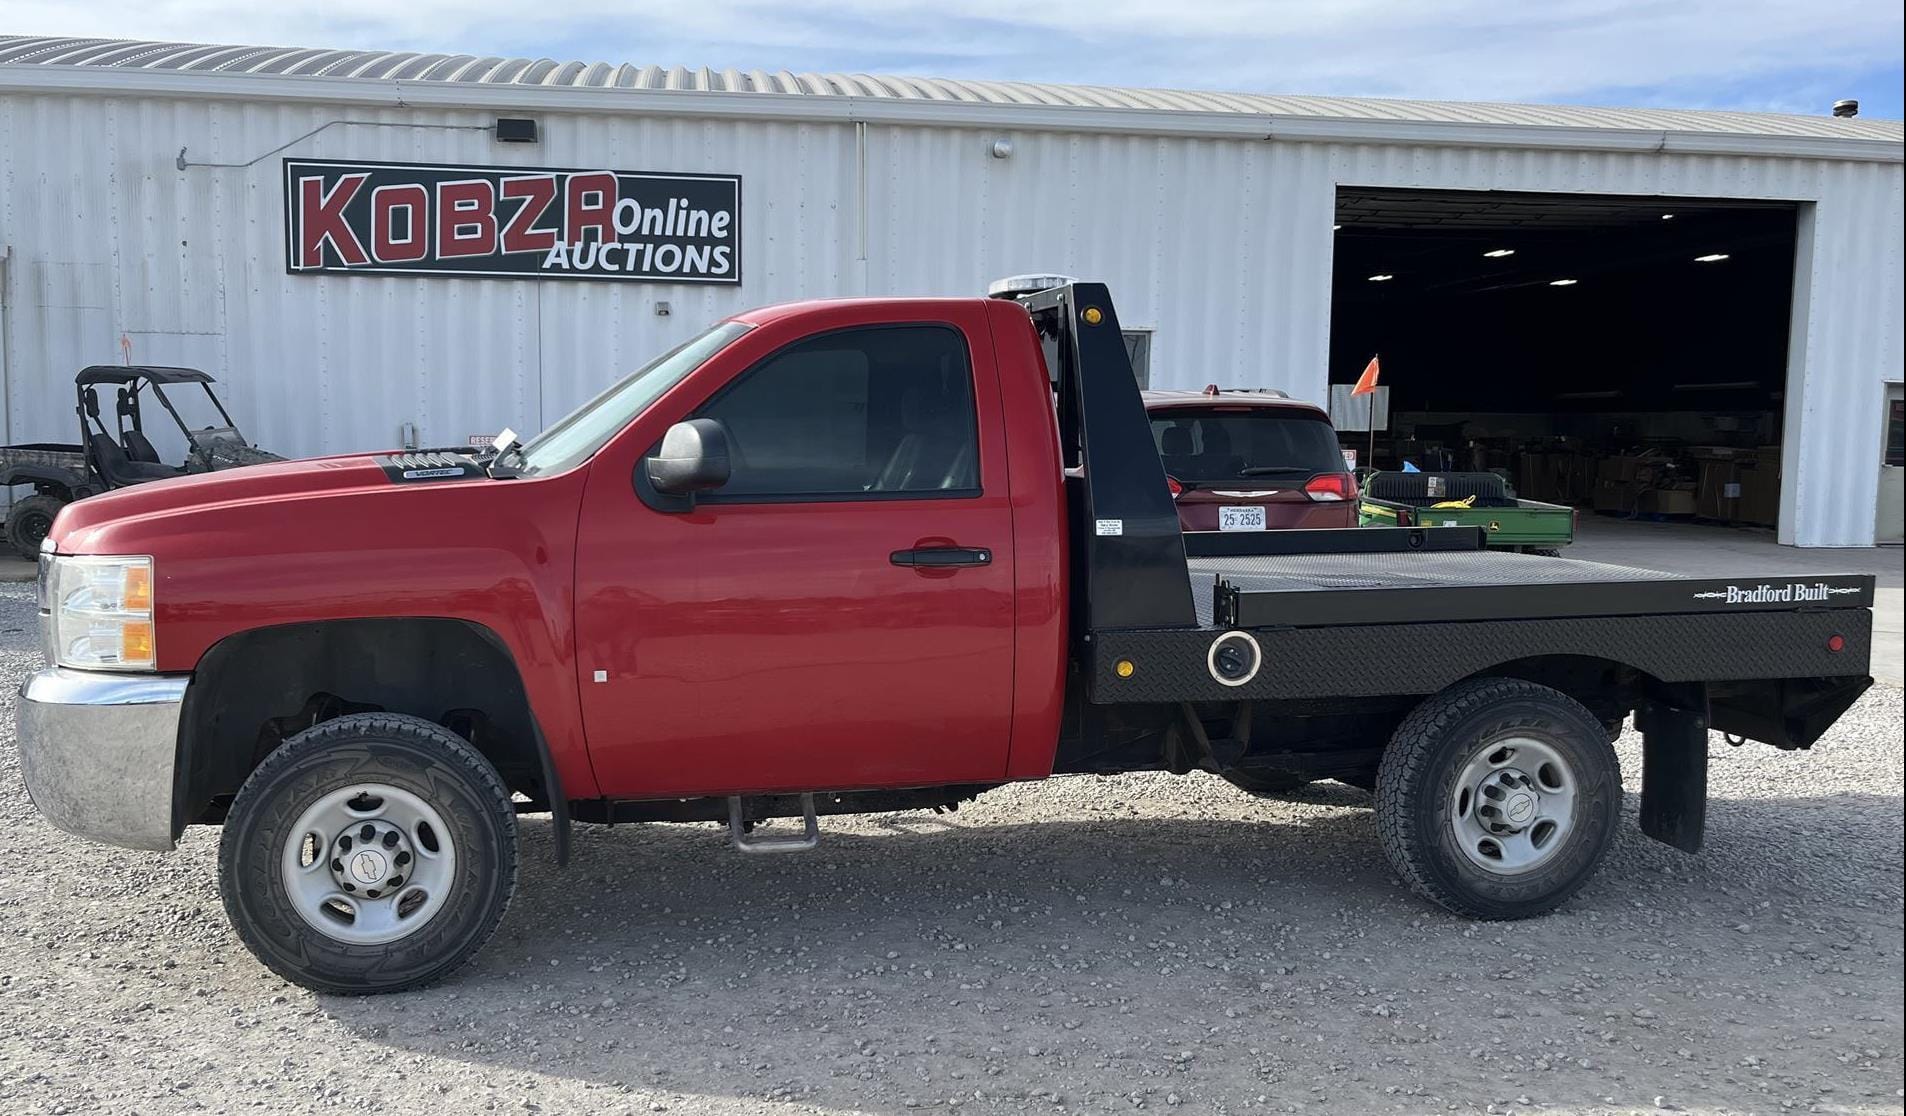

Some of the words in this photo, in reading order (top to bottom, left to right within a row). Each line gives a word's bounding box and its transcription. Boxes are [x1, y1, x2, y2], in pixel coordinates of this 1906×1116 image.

[299, 171, 618, 270] KOBZA
[612, 198, 730, 238] Online
[542, 240, 731, 274] AUCTIONS
[1224, 513, 1235, 526] 25
[1240, 513, 1261, 526] 2525
[1725, 584, 1792, 604] Bradford
[1794, 583, 1828, 601] Built
